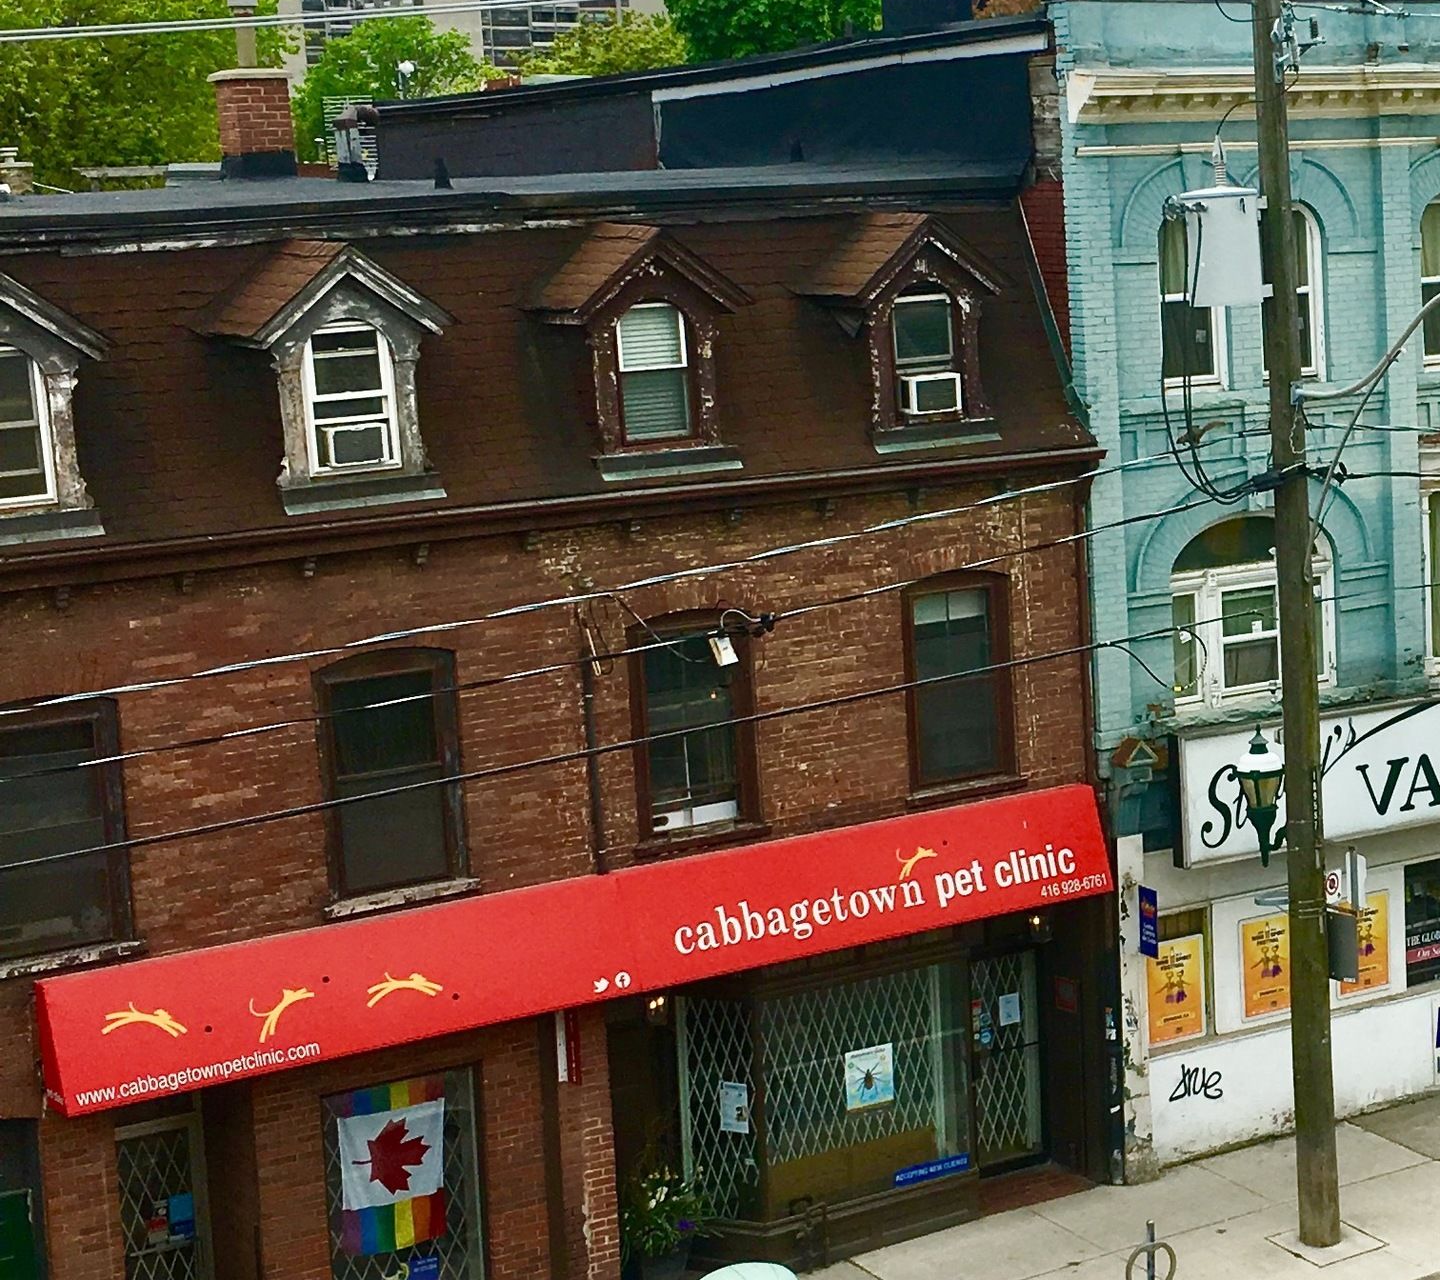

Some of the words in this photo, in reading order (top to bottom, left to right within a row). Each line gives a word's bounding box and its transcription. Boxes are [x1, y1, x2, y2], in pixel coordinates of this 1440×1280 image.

[1040, 881, 1060, 898] 416
[1061, 872, 1107, 895] 928-6761
[674, 878, 926, 955] cabbagetown
[934, 860, 987, 908] pet
[994, 843, 1077, 889] clinic
[1406, 935, 1421, 947] THE
[1417, 948, 1431, 959] On
[75, 1041, 321, 1107] www.cabbagetownpetclinic.com
